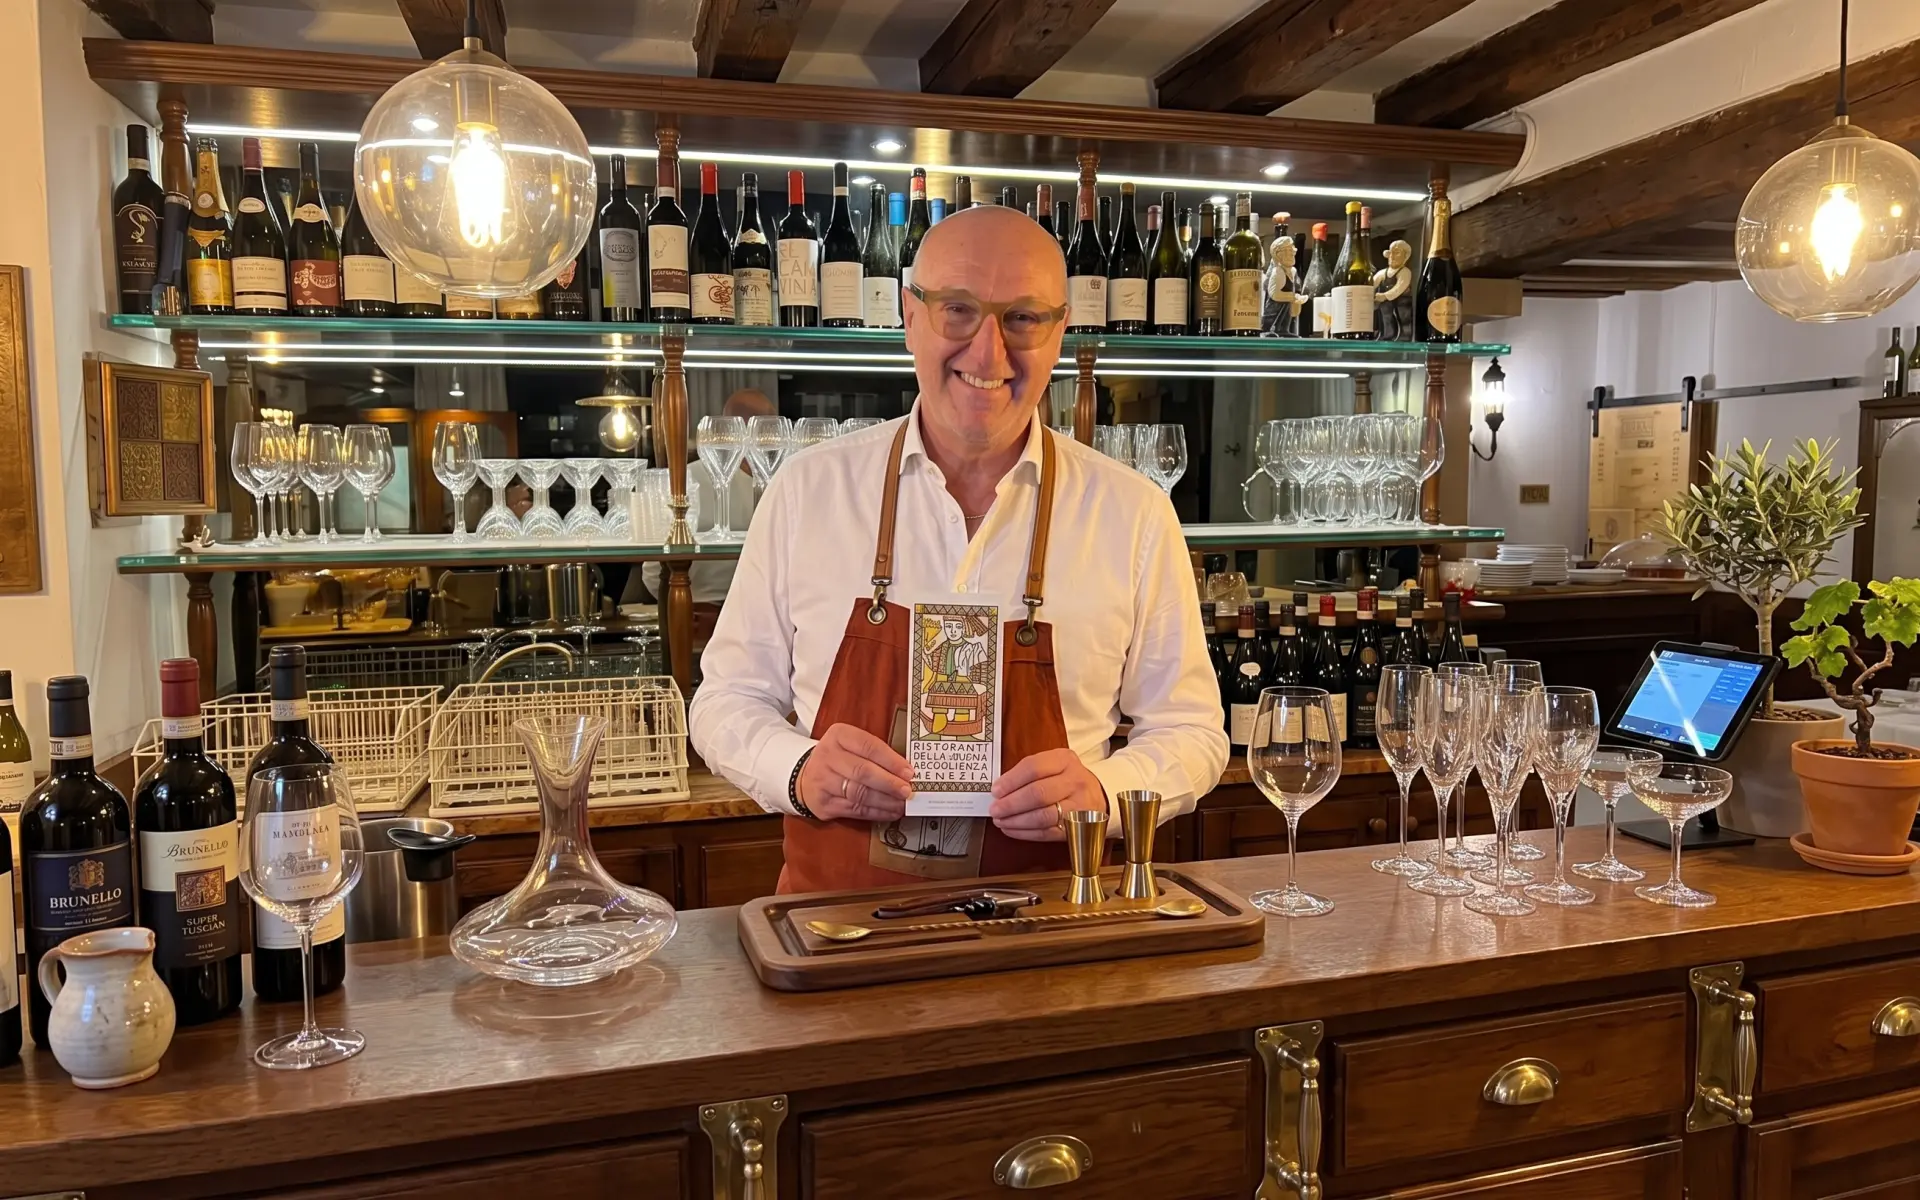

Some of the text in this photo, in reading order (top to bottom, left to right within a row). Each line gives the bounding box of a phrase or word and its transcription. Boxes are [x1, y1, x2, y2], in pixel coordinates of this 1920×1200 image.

[913, 752, 946, 761] DELLA
[50, 888, 122, 909] BRUNELLO
[186, 914, 218, 926] SUPER
